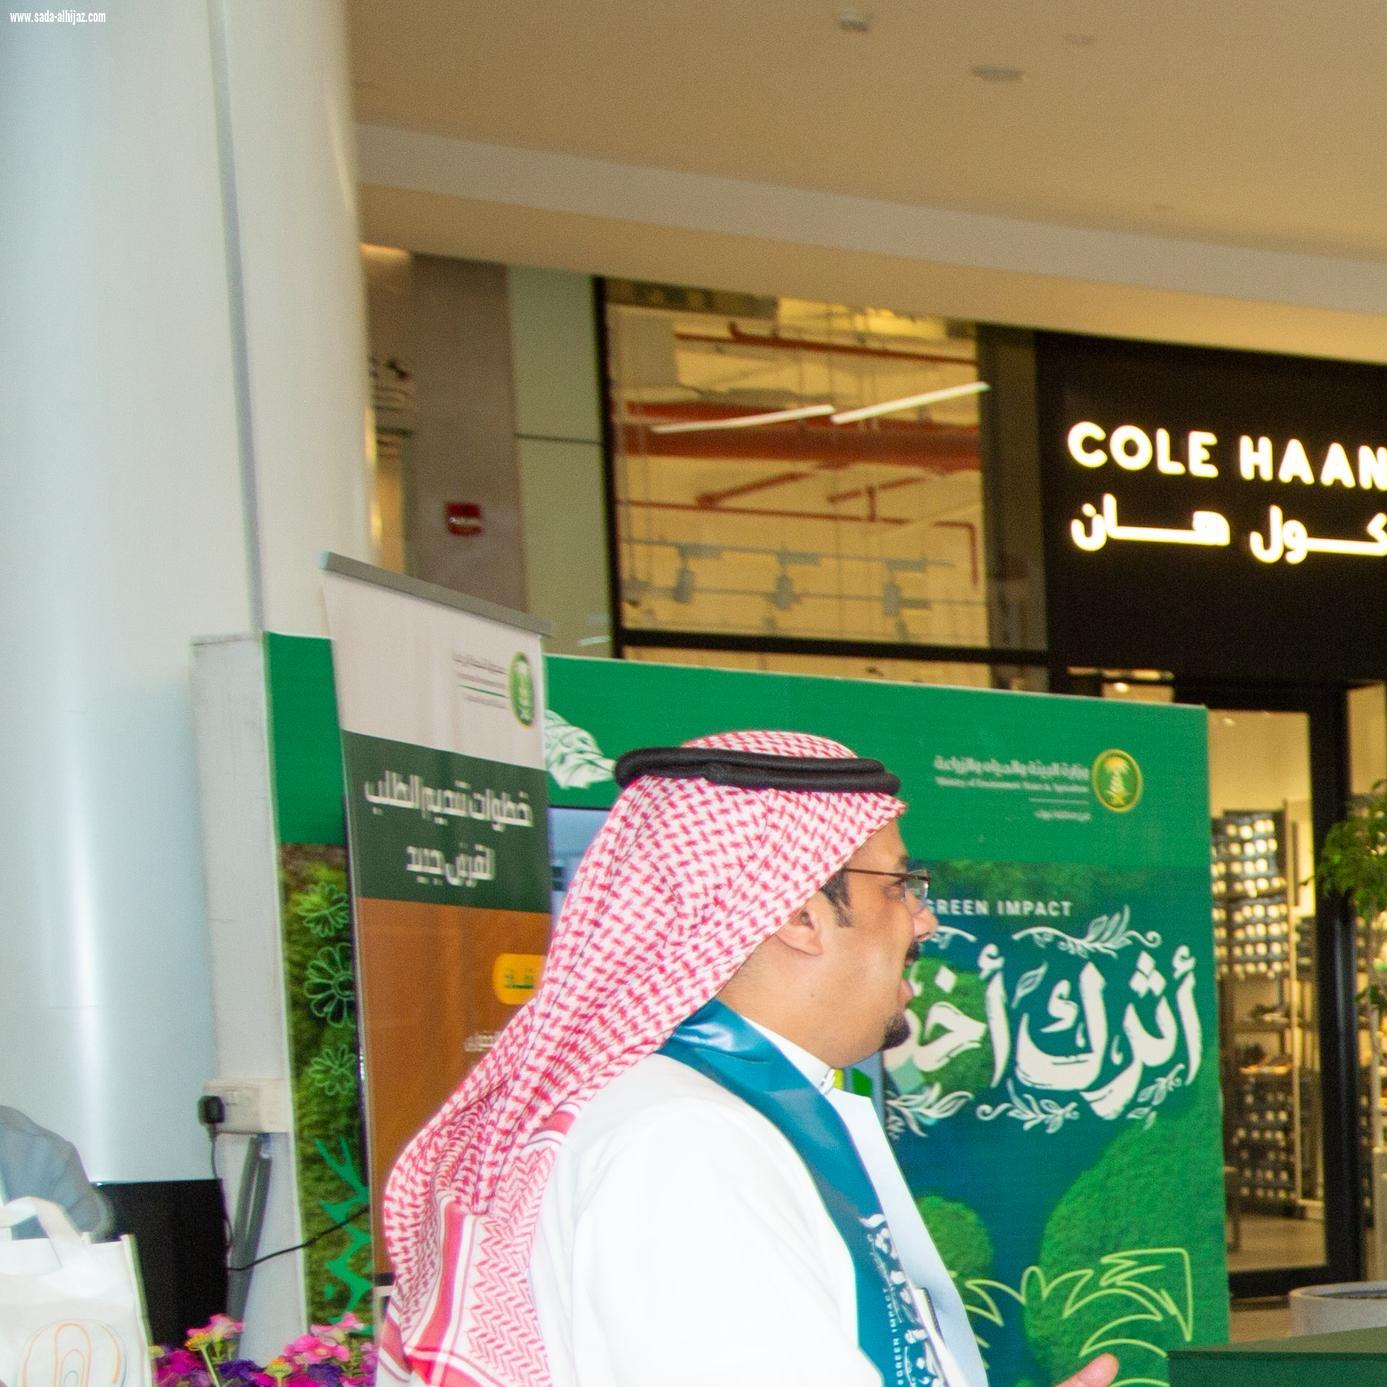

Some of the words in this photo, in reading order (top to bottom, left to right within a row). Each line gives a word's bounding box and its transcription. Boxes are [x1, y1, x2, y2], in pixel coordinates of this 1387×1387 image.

[1067, 421, 1219, 478] COLE
[1071, 493, 1231, 552] هان
[997, 899, 1073, 917] IMPACT
